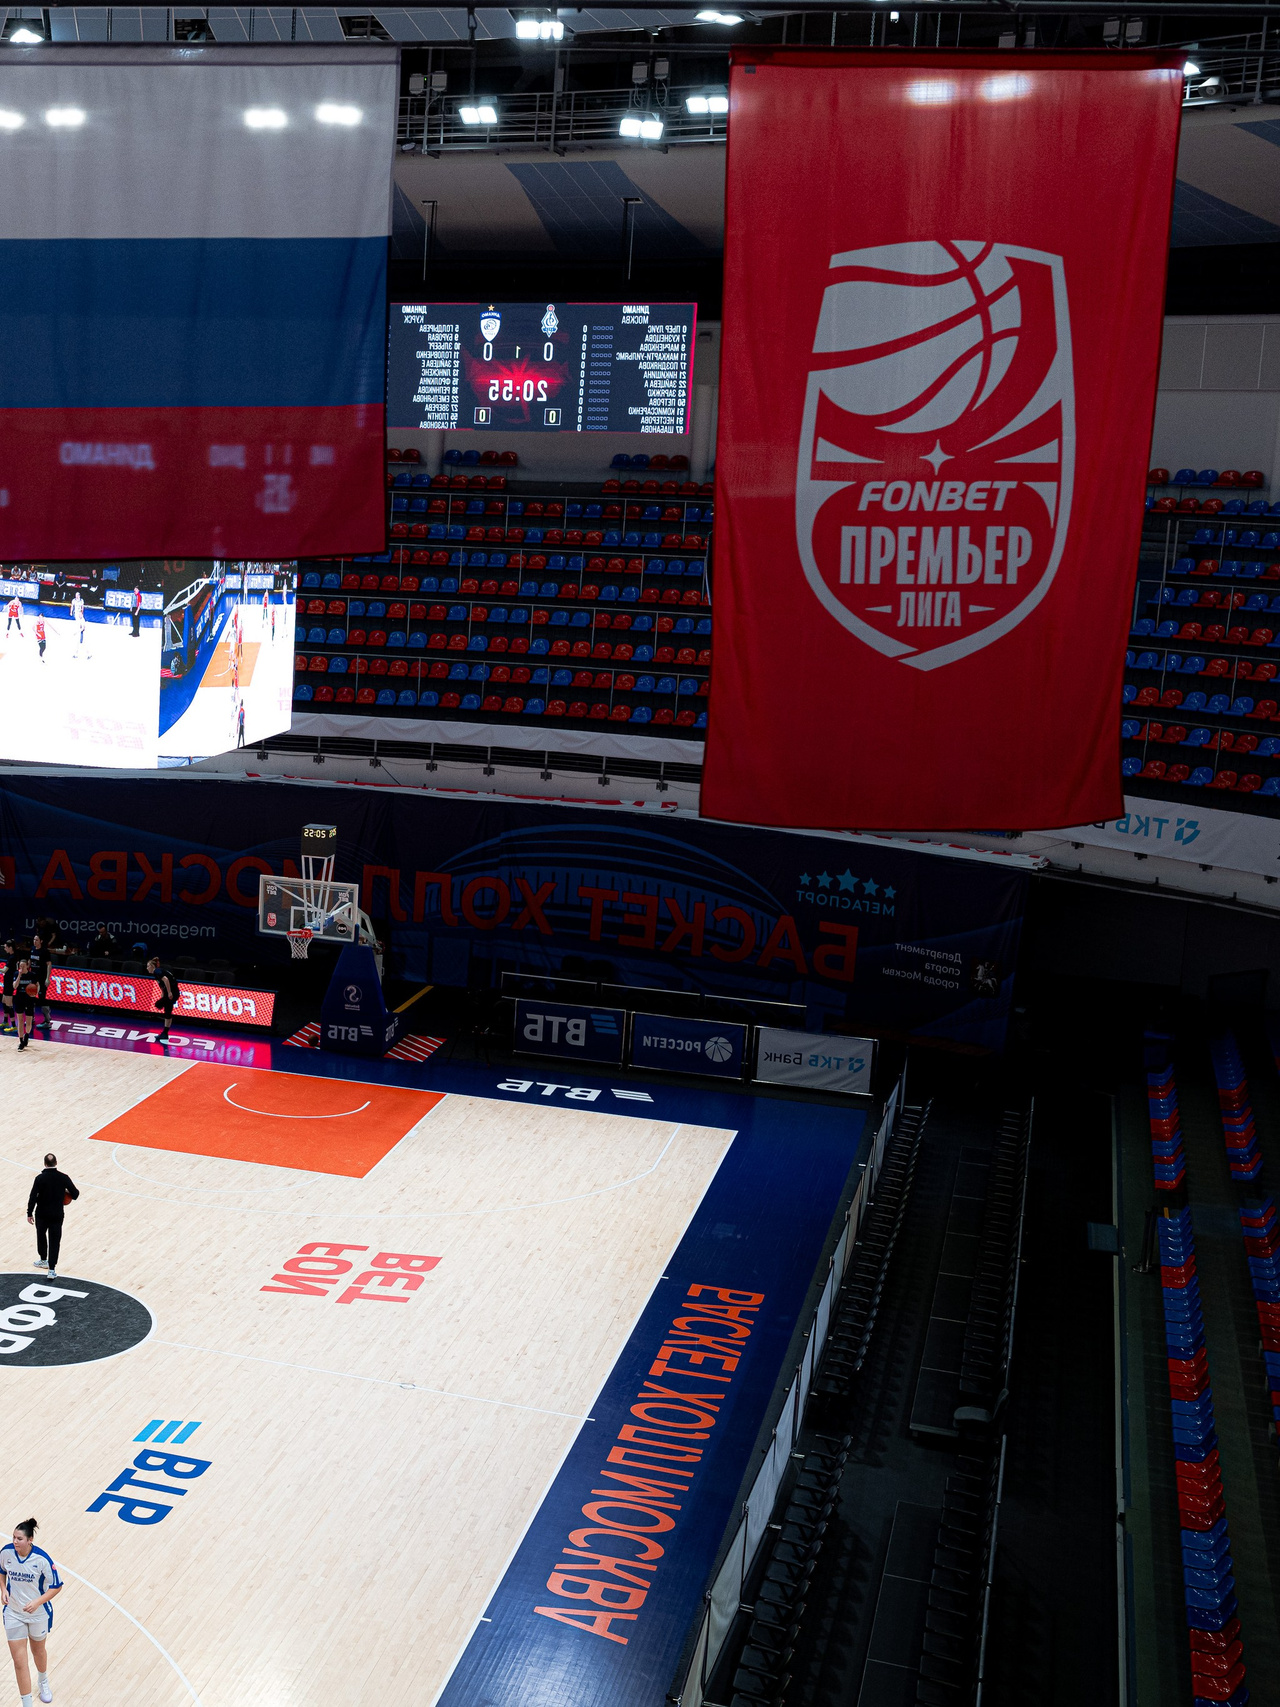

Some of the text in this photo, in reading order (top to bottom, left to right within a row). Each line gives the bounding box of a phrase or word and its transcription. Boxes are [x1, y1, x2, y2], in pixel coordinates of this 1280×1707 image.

[858, 481, 1018, 511] FONBET
[841, 526, 1033, 584] ПРЕМЬЕР
[897, 592, 961, 627] ЛИГА
